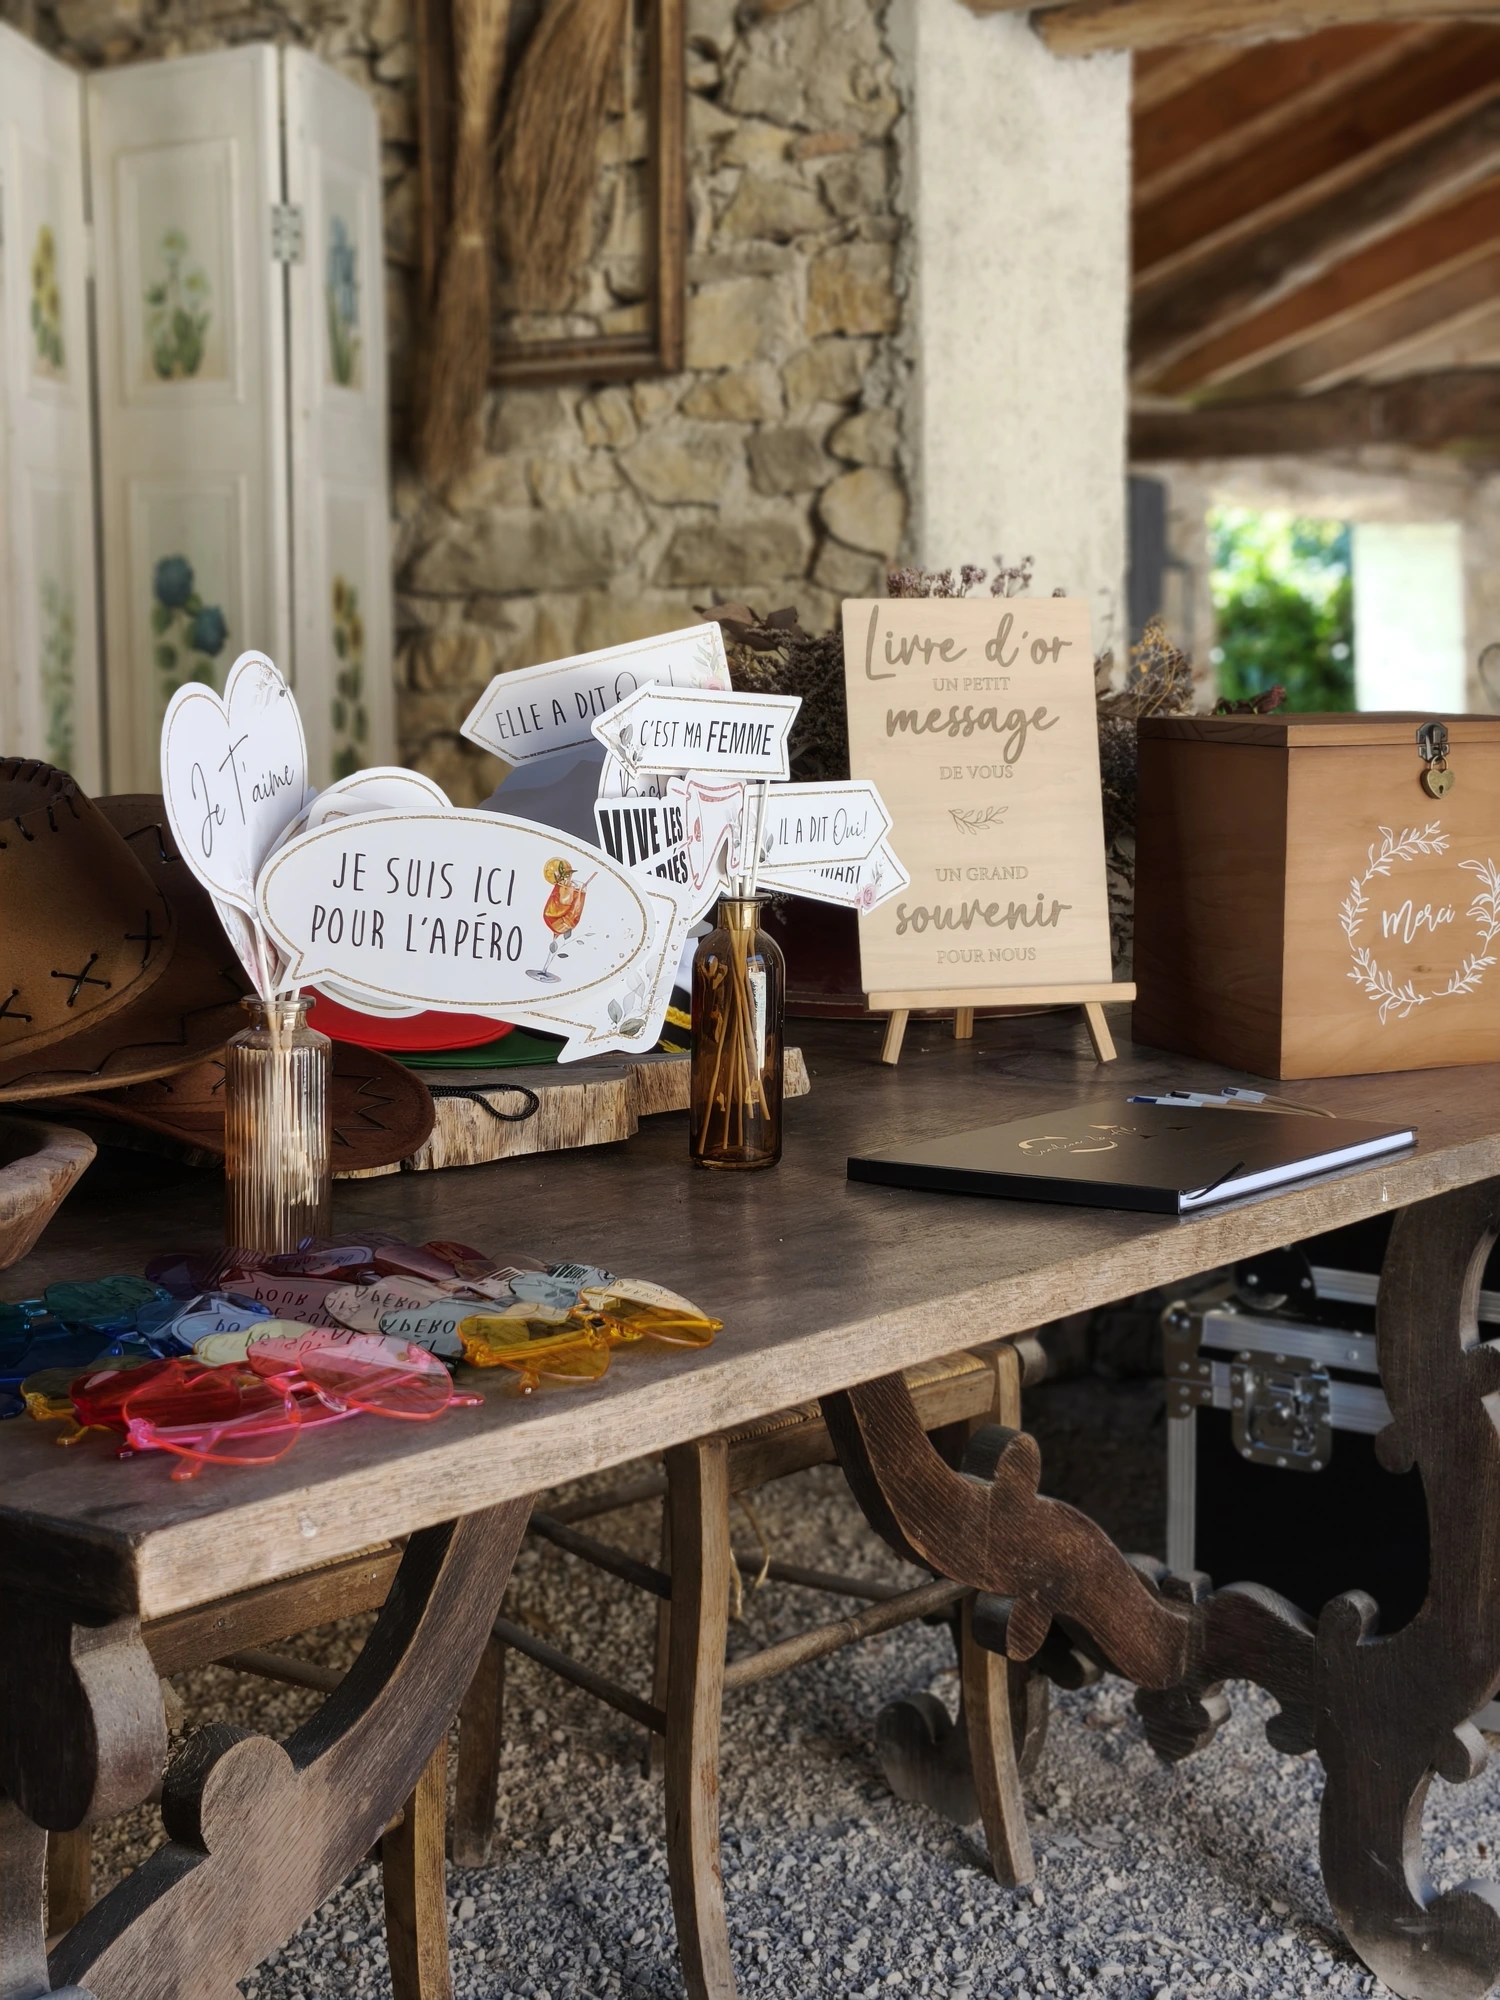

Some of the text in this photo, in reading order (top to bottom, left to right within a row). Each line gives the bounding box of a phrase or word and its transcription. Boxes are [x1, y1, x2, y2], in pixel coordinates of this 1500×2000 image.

[865, 604, 1073, 680] Livre d'or
[932, 677, 1011, 692] UN PETIT
[495, 703, 544, 739] ELLE
[552, 699, 567, 726] A
[574, 686, 605, 719] DIT
[886, 705, 1060, 764] message
[640, 720, 774, 756] C'EST MA FEMME
[939, 765, 1013, 780] DE VOUS
[191, 734, 294, 858] Je T'aime
[598, 806, 683, 868] VIVE LES
[779, 808, 868, 846] IL A DIT Oui!
[332, 853, 515, 906] JE SUIS ICI
[935, 866, 1029, 882] UN GRAND
[311, 905, 523, 962] POUR L'APÉRO
[895, 893, 1072, 936] souvenir
[1382, 900, 1455, 944] Merci
[936, 947, 1037, 964] POUR NOUS
